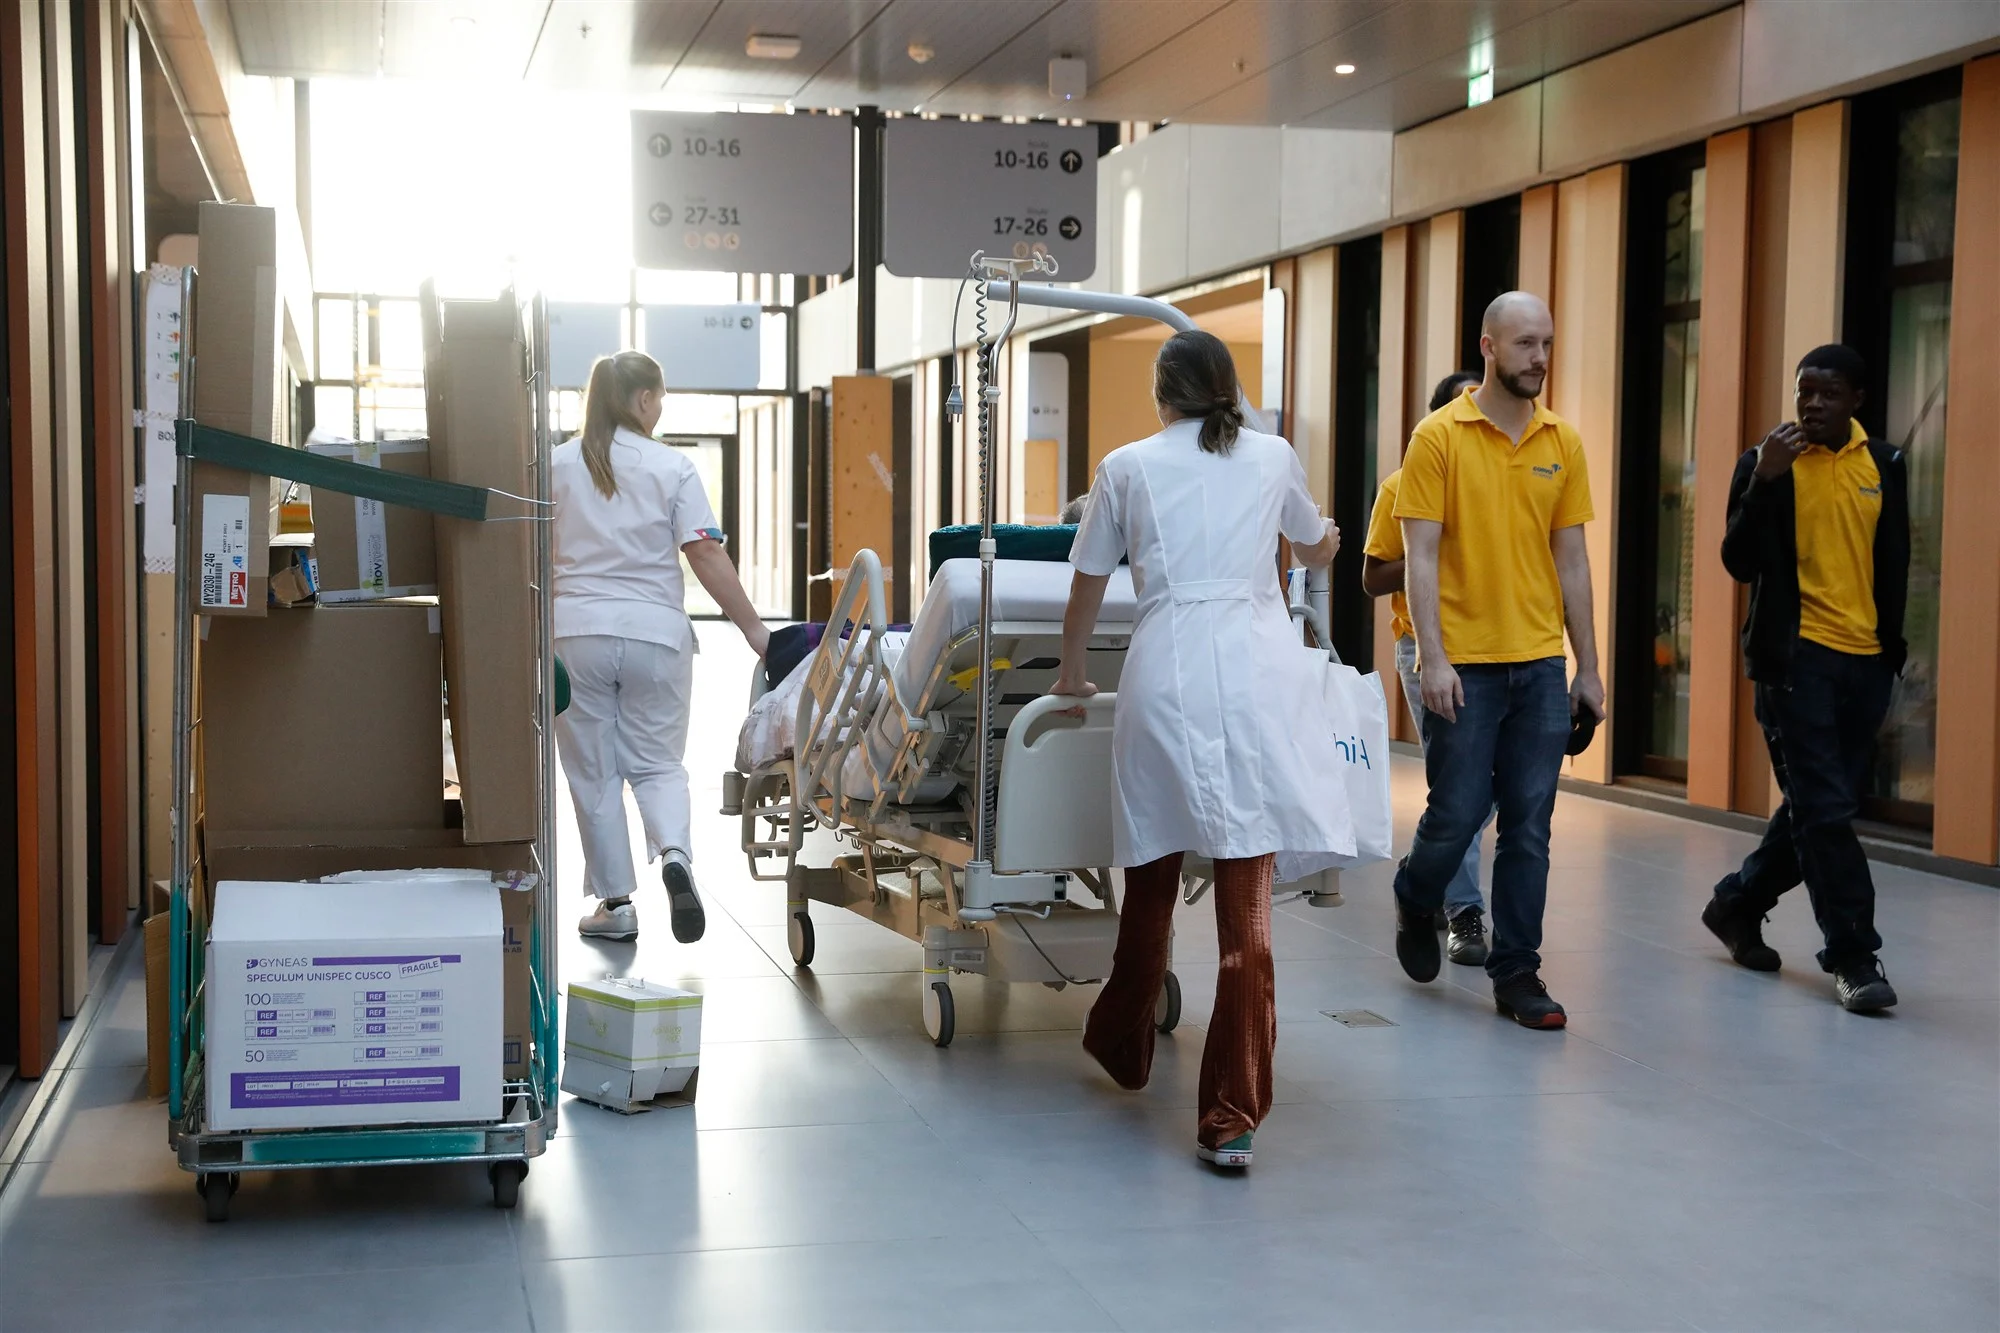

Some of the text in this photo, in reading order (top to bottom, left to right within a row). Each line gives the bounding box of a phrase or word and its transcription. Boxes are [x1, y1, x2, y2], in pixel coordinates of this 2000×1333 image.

[684, 138, 741, 157] 10-16
[994, 149, 1049, 169] 10-16
[685, 206, 741, 226] 27-31
[993, 216, 1048, 236] 17-26
[203, 553, 216, 605] MY2030-24G
[230, 573, 239, 600] METRO
[259, 957, 308, 968] GYNEAS
[401, 960, 439, 975] FRAGILE
[246, 971, 392, 983] SPECULUM UNISPEC CUSCO
[245, 992, 271, 1006] 100
[245, 1049, 265, 1063] 50
[369, 1049, 383, 1057] REF
